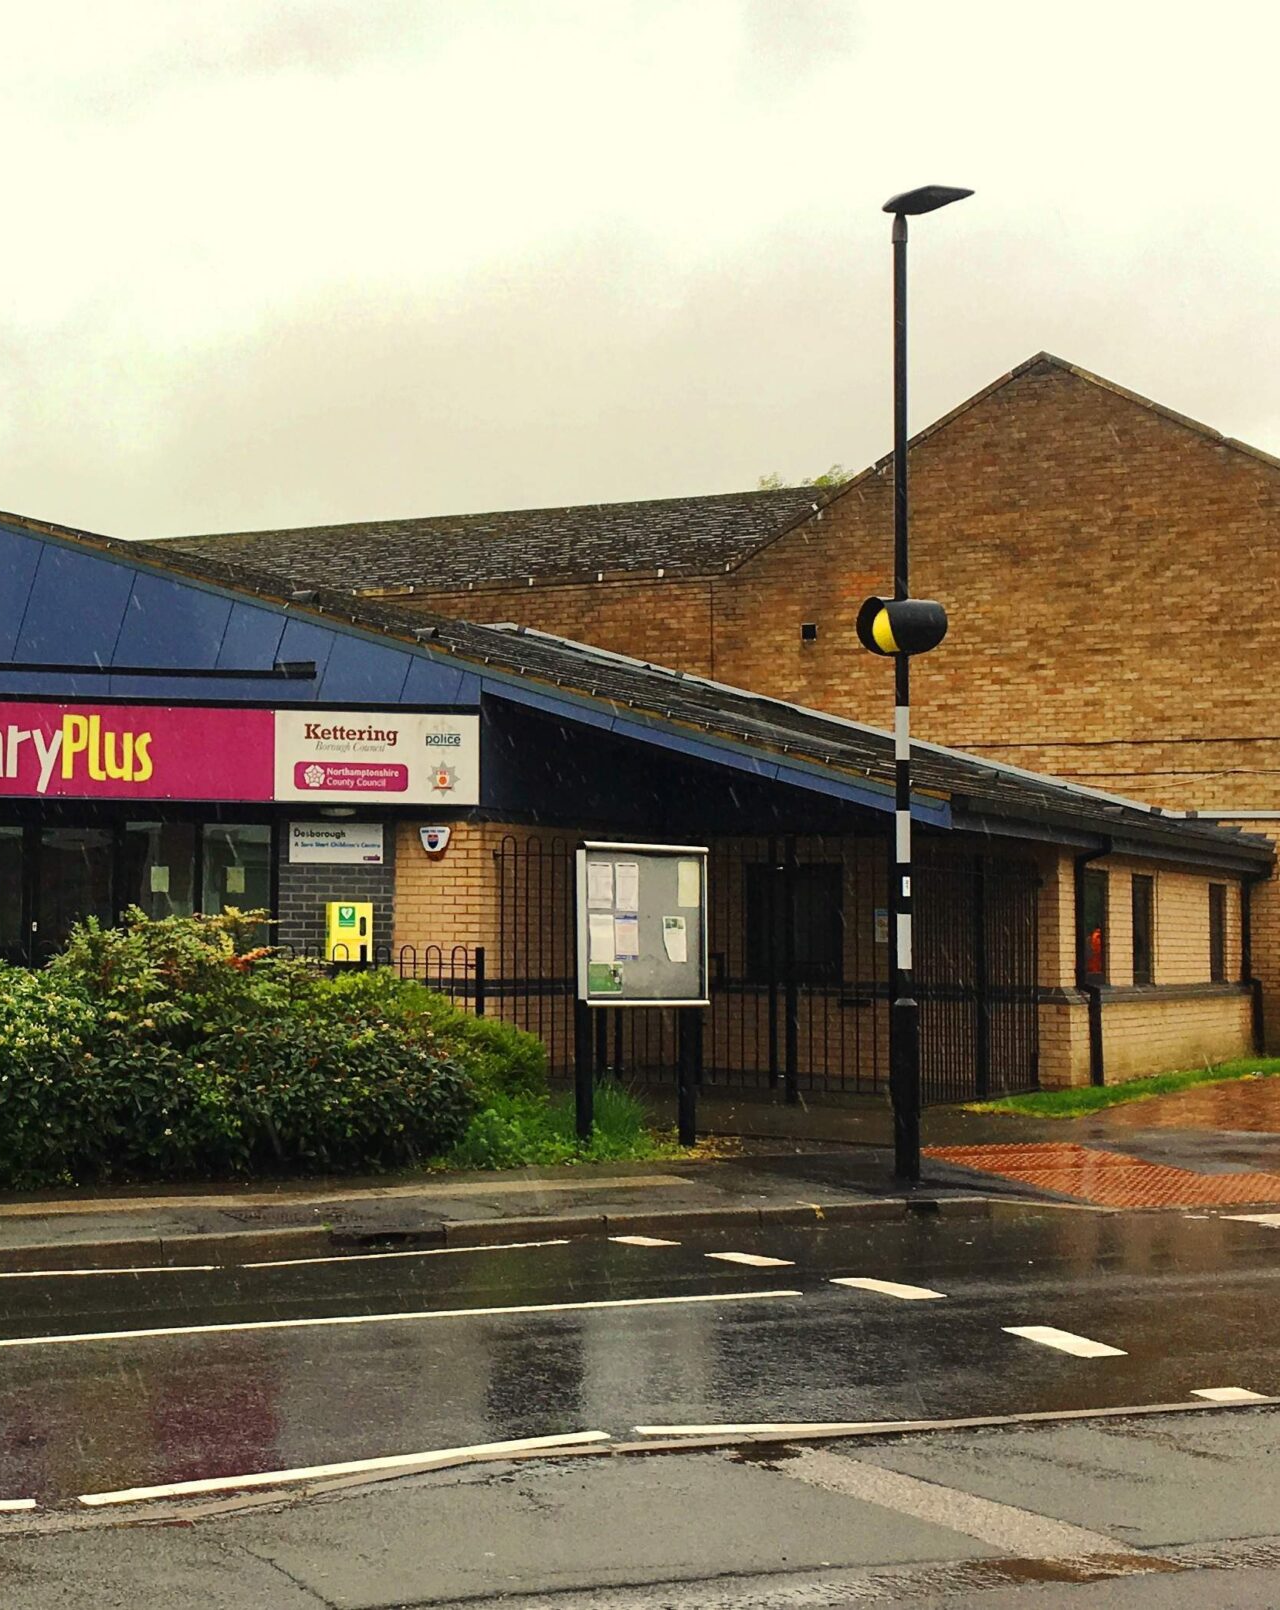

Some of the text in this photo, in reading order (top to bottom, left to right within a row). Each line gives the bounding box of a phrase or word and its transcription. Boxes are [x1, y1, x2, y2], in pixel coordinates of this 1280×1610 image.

[304, 723, 399, 746] Kettering
[426, 734, 461, 746] police
[315, 741, 386, 752] Borough Council
[326, 768, 400, 778] Northamptonshire
[326, 777, 387, 788] County Council
[293, 828, 346, 839] Desborough
